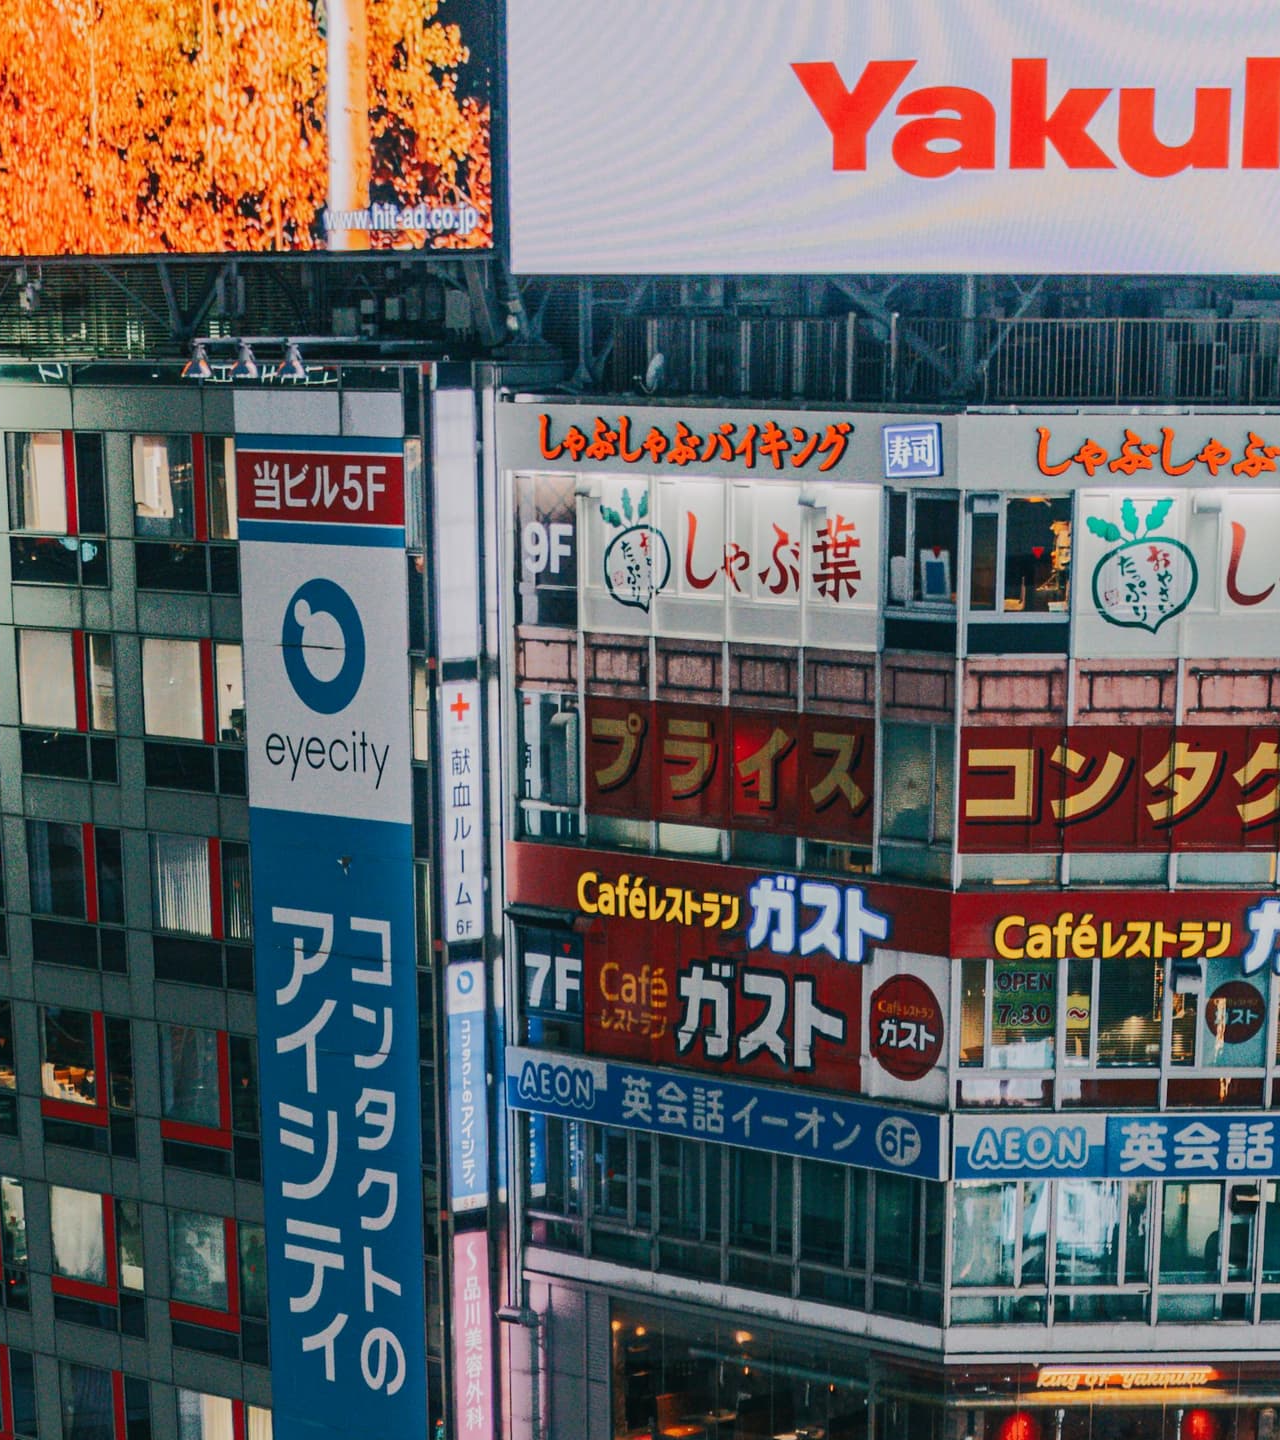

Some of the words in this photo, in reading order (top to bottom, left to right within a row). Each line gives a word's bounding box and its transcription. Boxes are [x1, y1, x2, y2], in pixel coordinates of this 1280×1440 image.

[322, 202, 478, 235] www.hit-ad.co.jp
[538, 414, 854, 472] しゃぶしゃぶバイキング
[888, 433, 936, 469] 寿司
[253, 460, 387, 512] 当ビル5F
[524, 521, 574, 575] 9F
[685, 510, 862, 604] しゃぶ葉
[266, 730, 390, 790] eyecity
[591, 712, 870, 814] プライス
[451, 748, 473, 907] 献血ルーム
[456, 919, 473, 935] 6F
[576, 871, 740, 931] Caféレストラン
[748, 875, 889, 963] ガスト
[994, 911, 1232, 960] Caféレストラン
[524, 951, 583, 1012] 7F
[996, 971, 1053, 992] OPEN
[677, 960, 846, 1070] ガスト
[879, 1018, 936, 1051] ガスト
[998, 1003, 1051, 1026] 7:30
[520, 1062, 594, 1107] AEON
[621, 1074, 862, 1152] 英会話イーオン
[878, 1122, 918, 1158] 6F
[271, 906, 346, 1383] アイシティ
[350, 915, 407, 1395] コンタクトの
[972, 1128, 1086, 1166] AEON
[463, 1275, 483, 1431] 品川美容外科
